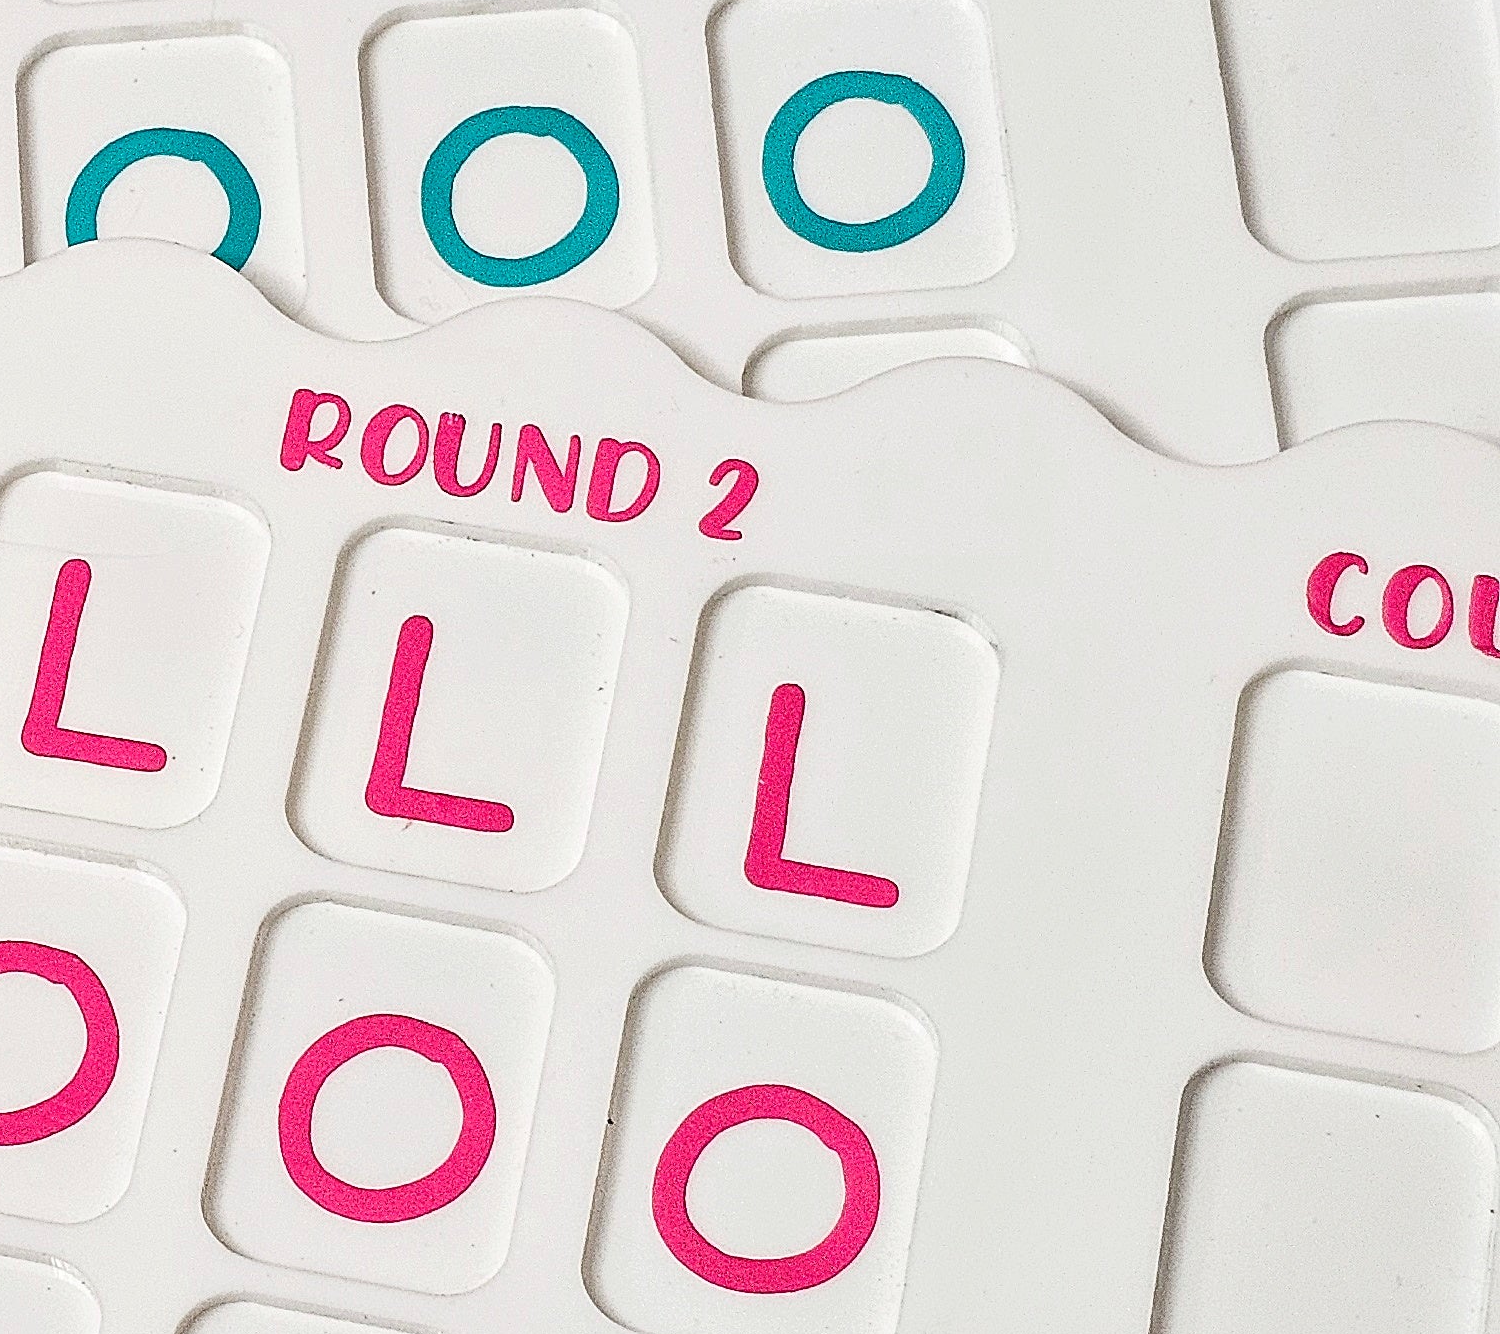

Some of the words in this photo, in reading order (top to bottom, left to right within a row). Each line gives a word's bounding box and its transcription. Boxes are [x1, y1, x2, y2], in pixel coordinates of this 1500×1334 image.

[421, 106, 619, 287] O
[762, 71, 965, 253] O
[280, 389, 660, 522] ROUND
[699, 459, 759, 540] 2
[21, 559, 167, 772] L
[365, 615, 514, 832] L
[744, 683, 899, 908] L
[278, 1014, 496, 1223] O
[652, 1084, 880, 1294] O
